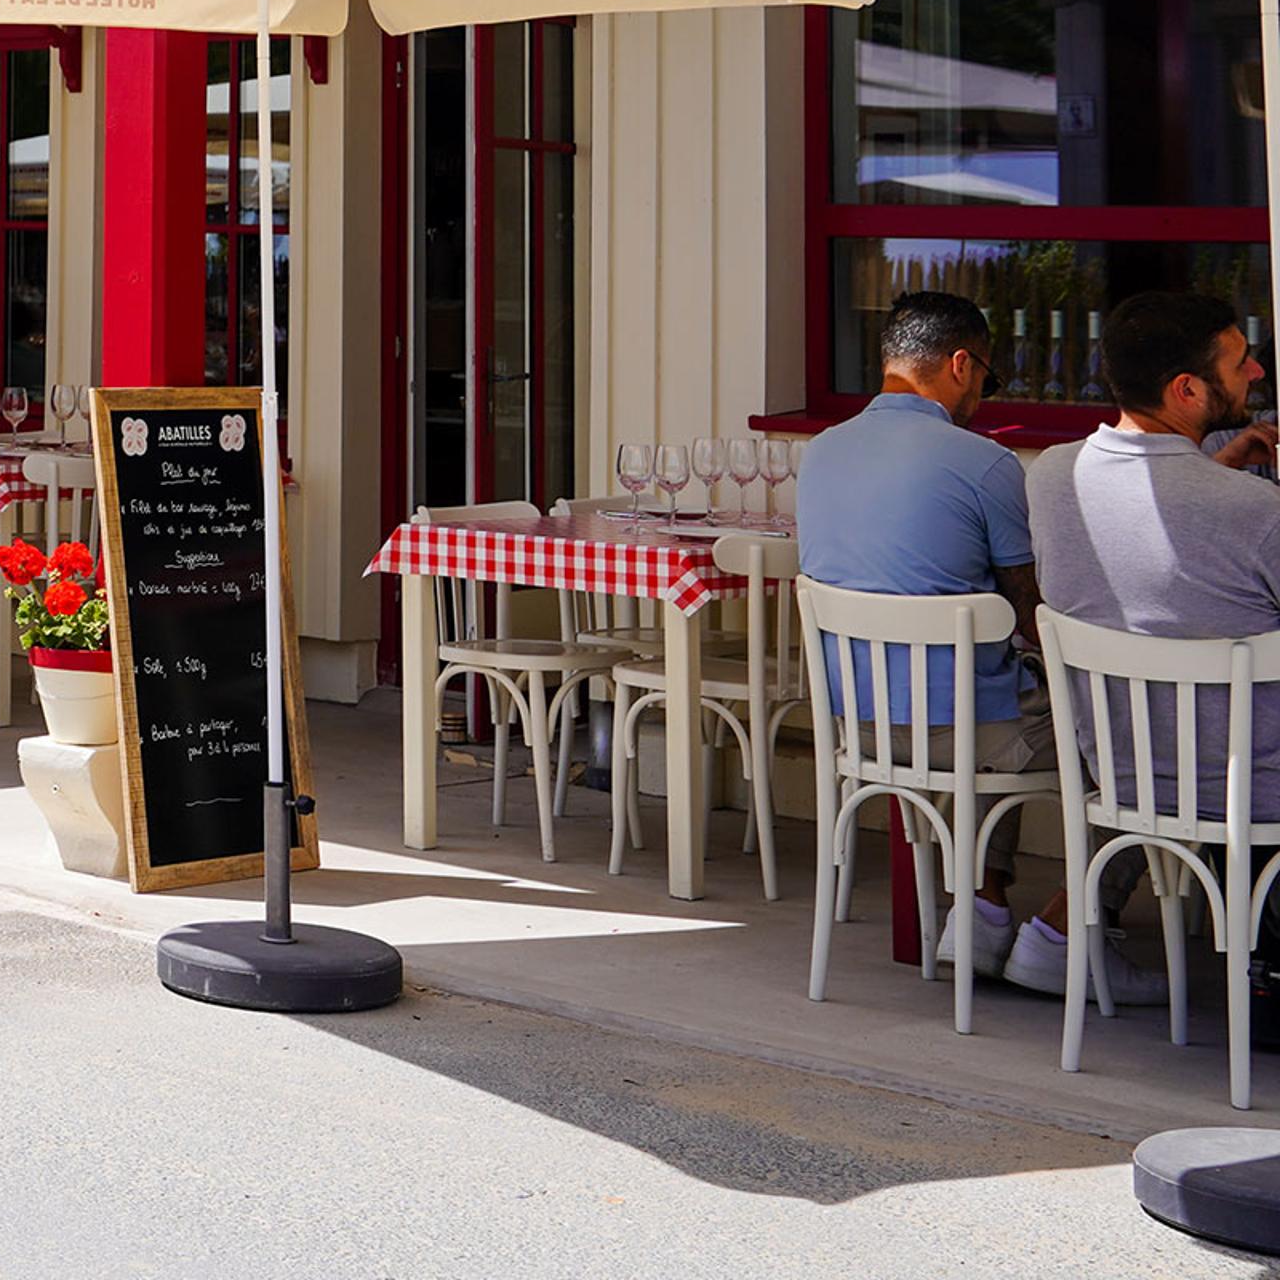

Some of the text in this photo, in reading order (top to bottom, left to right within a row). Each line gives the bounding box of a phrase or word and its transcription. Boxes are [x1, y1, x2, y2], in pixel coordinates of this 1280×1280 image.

[158, 425, 213, 441] ABATILLES
[161, 461, 183, 478] Plat
[188, 467, 200, 478] du
[139, 581, 171, 596] Dorade
[251, 651, 268, 669] 45
